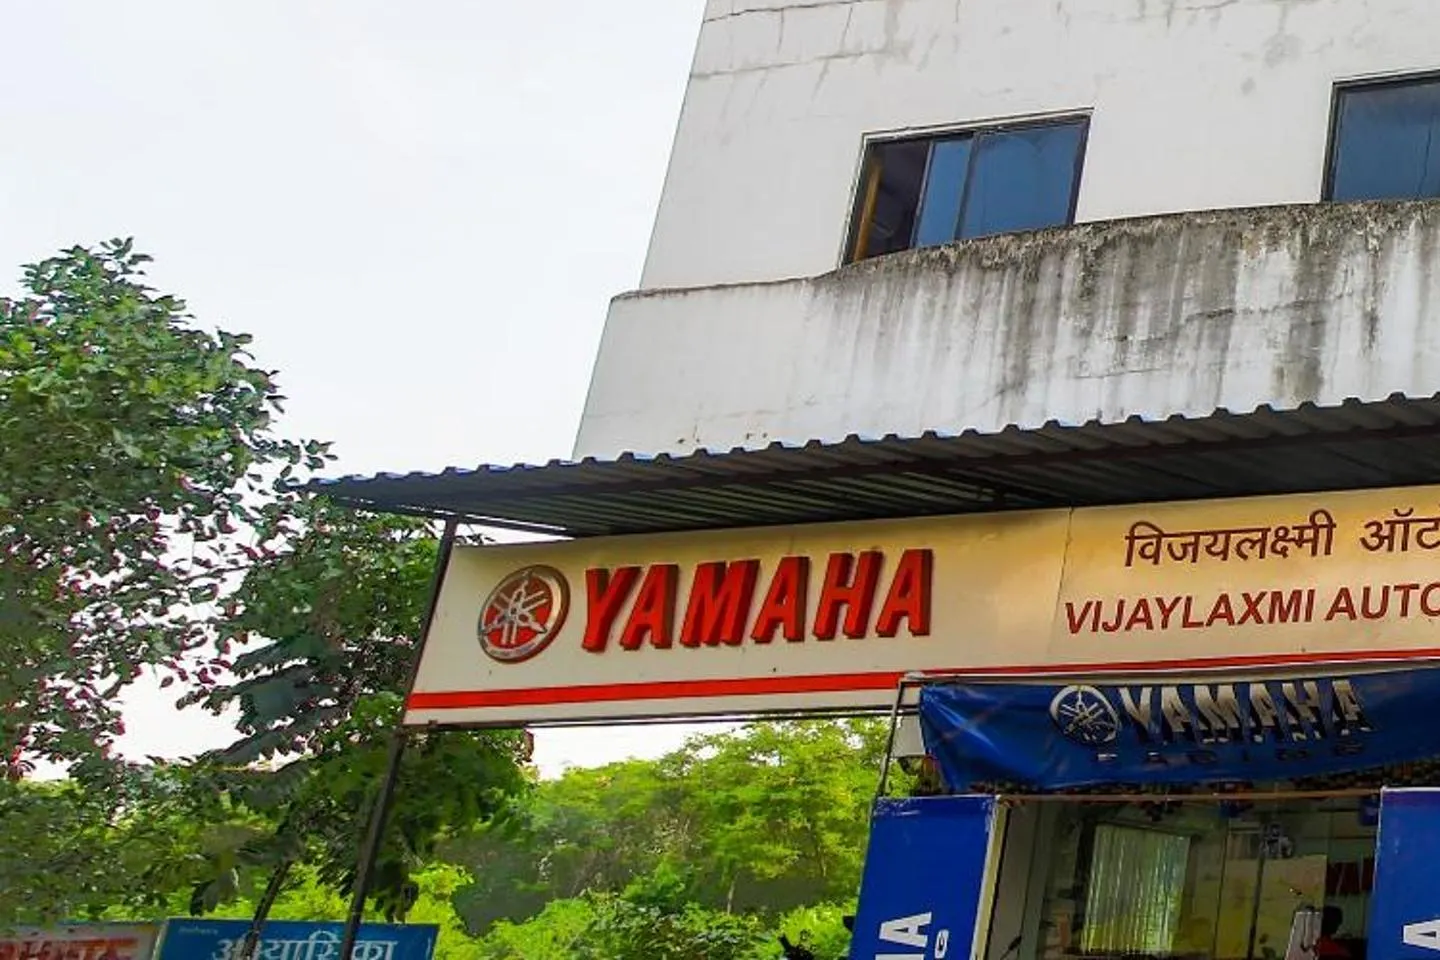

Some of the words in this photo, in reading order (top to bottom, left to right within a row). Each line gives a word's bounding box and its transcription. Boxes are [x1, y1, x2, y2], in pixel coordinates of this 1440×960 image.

[1125, 509, 1336, 567] विजयलक्ष्मी
[581, 549, 934, 652] YAMAHA
[1064, 588, 1315, 634] VIJAYLAXMI
[1117, 678, 1378, 746] YAMAHA
